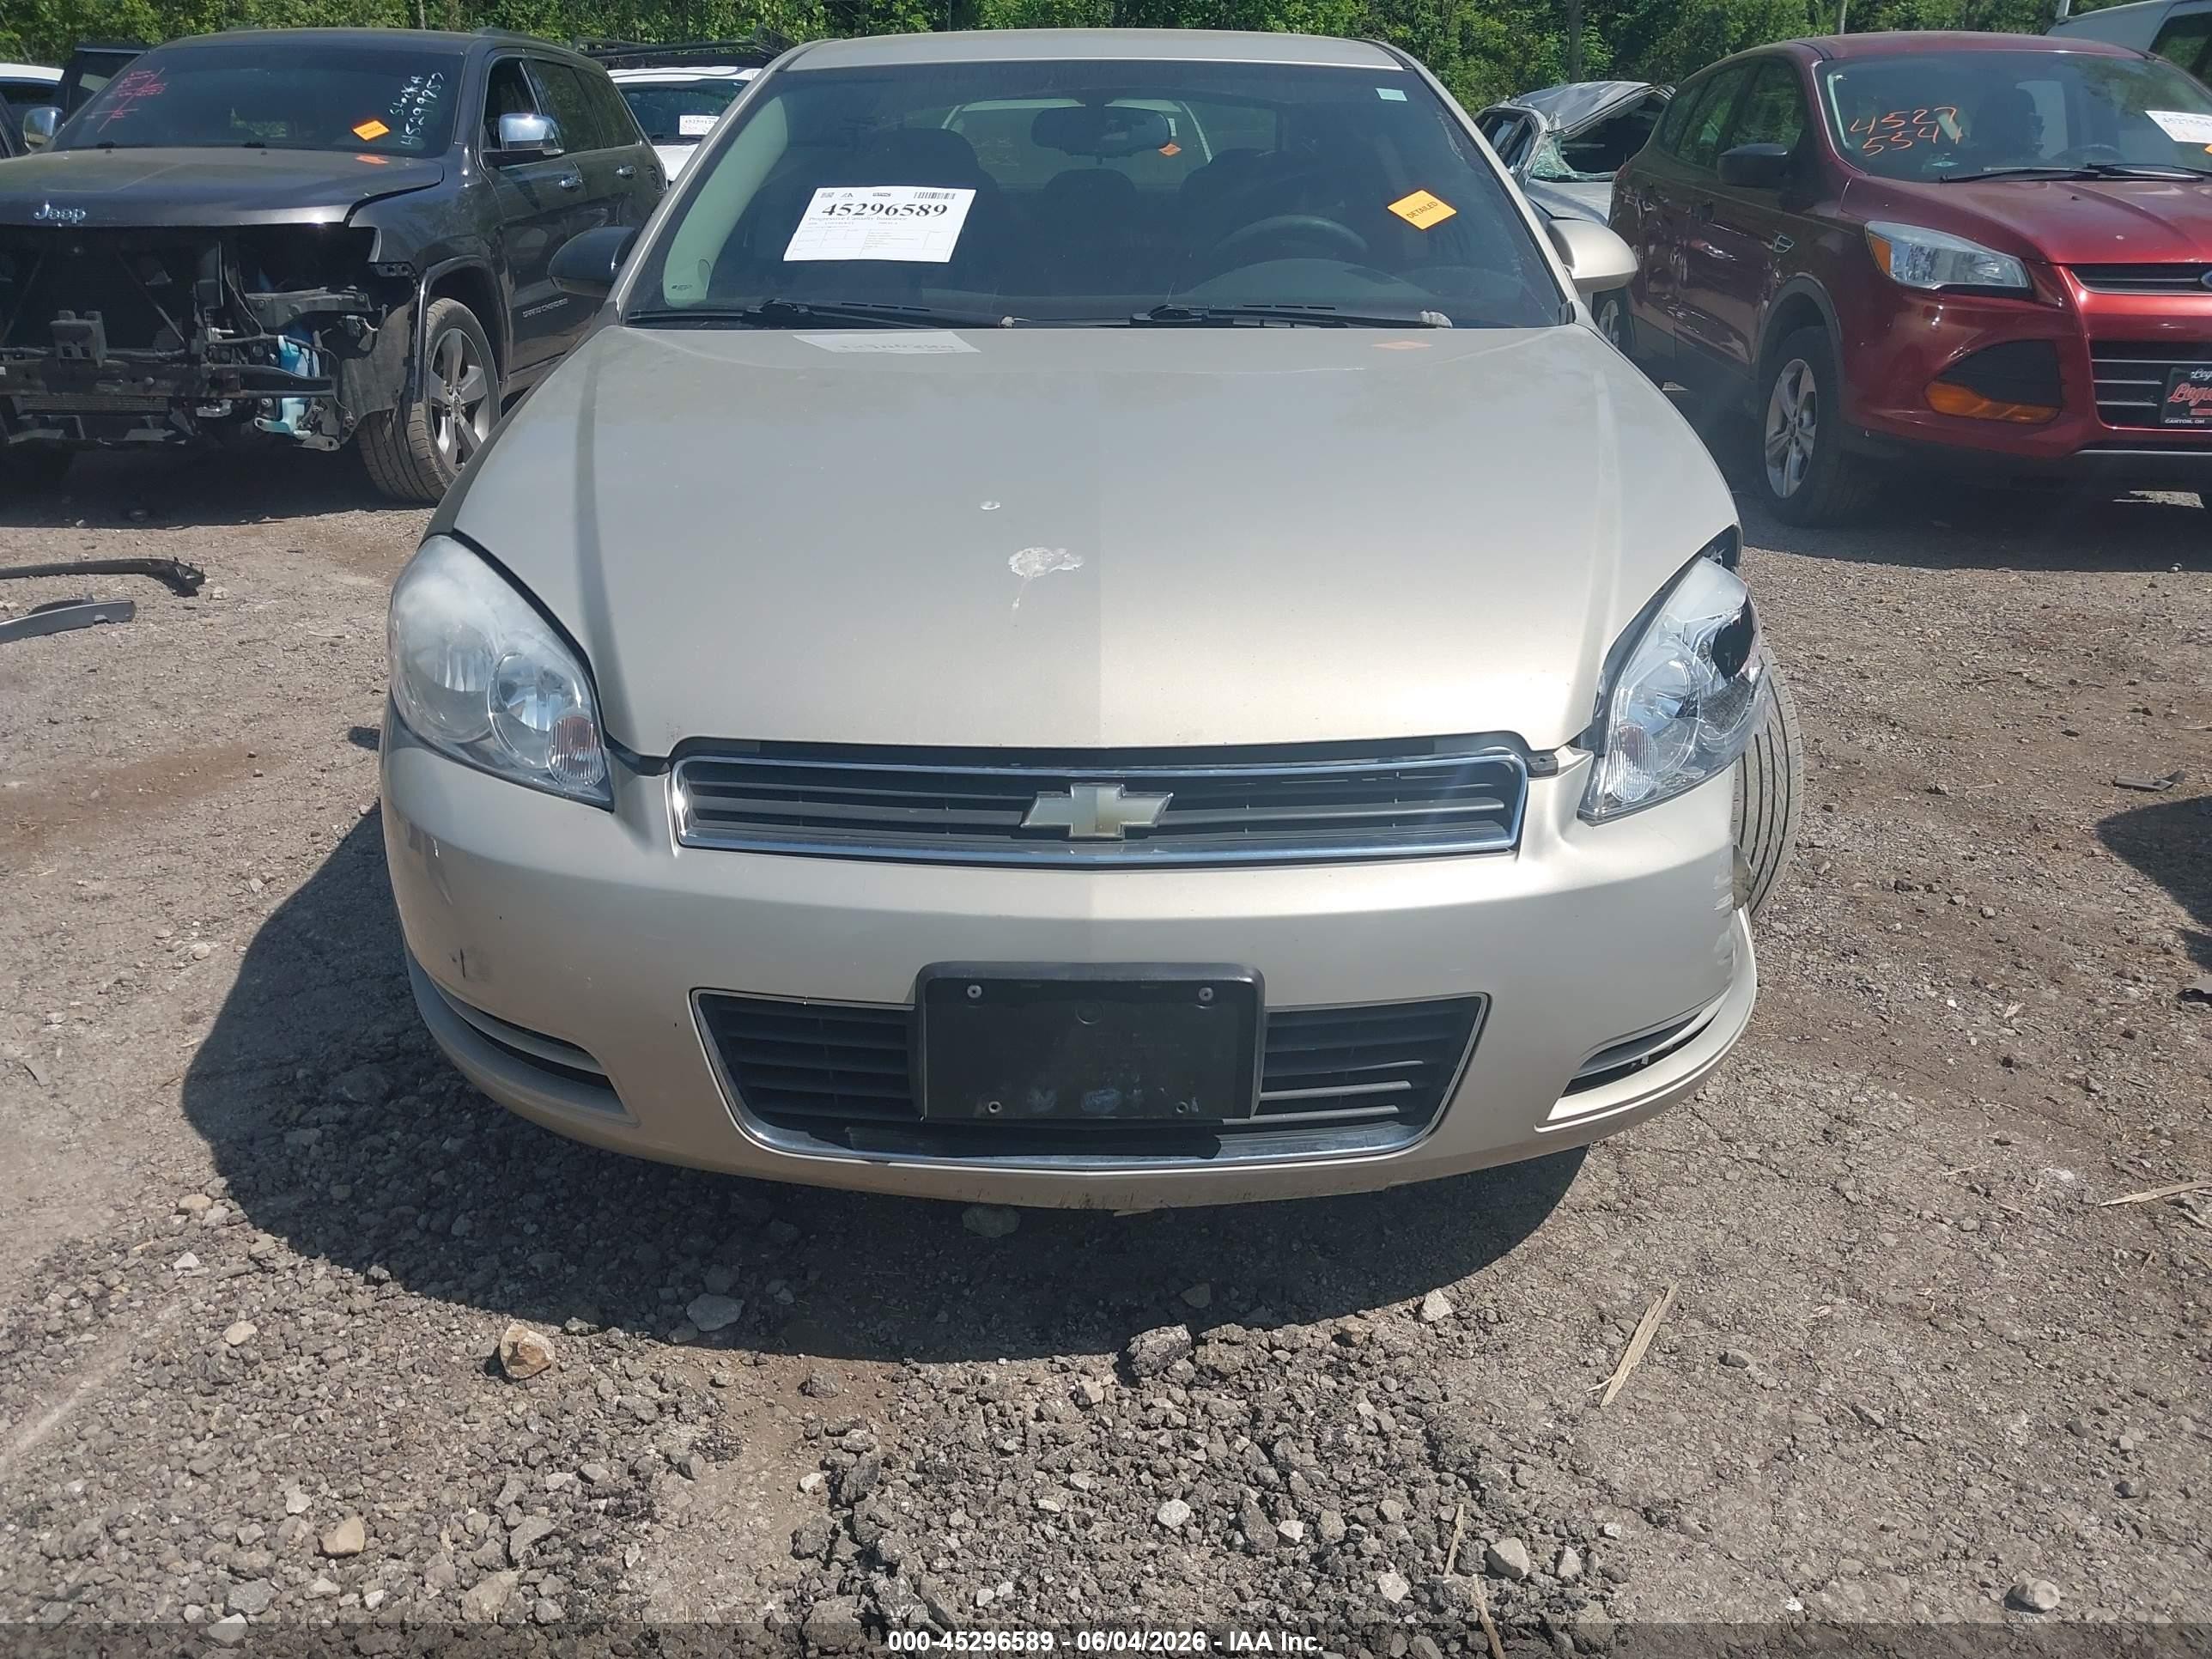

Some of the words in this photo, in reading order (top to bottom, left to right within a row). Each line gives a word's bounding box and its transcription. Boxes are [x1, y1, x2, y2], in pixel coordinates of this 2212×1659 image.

[1850, 106, 1957, 135] 4527
[34, 200, 87, 223] Jeep
[822, 203, 948, 216] 45296589
[1406, 201, 1438, 219] DETAILED
